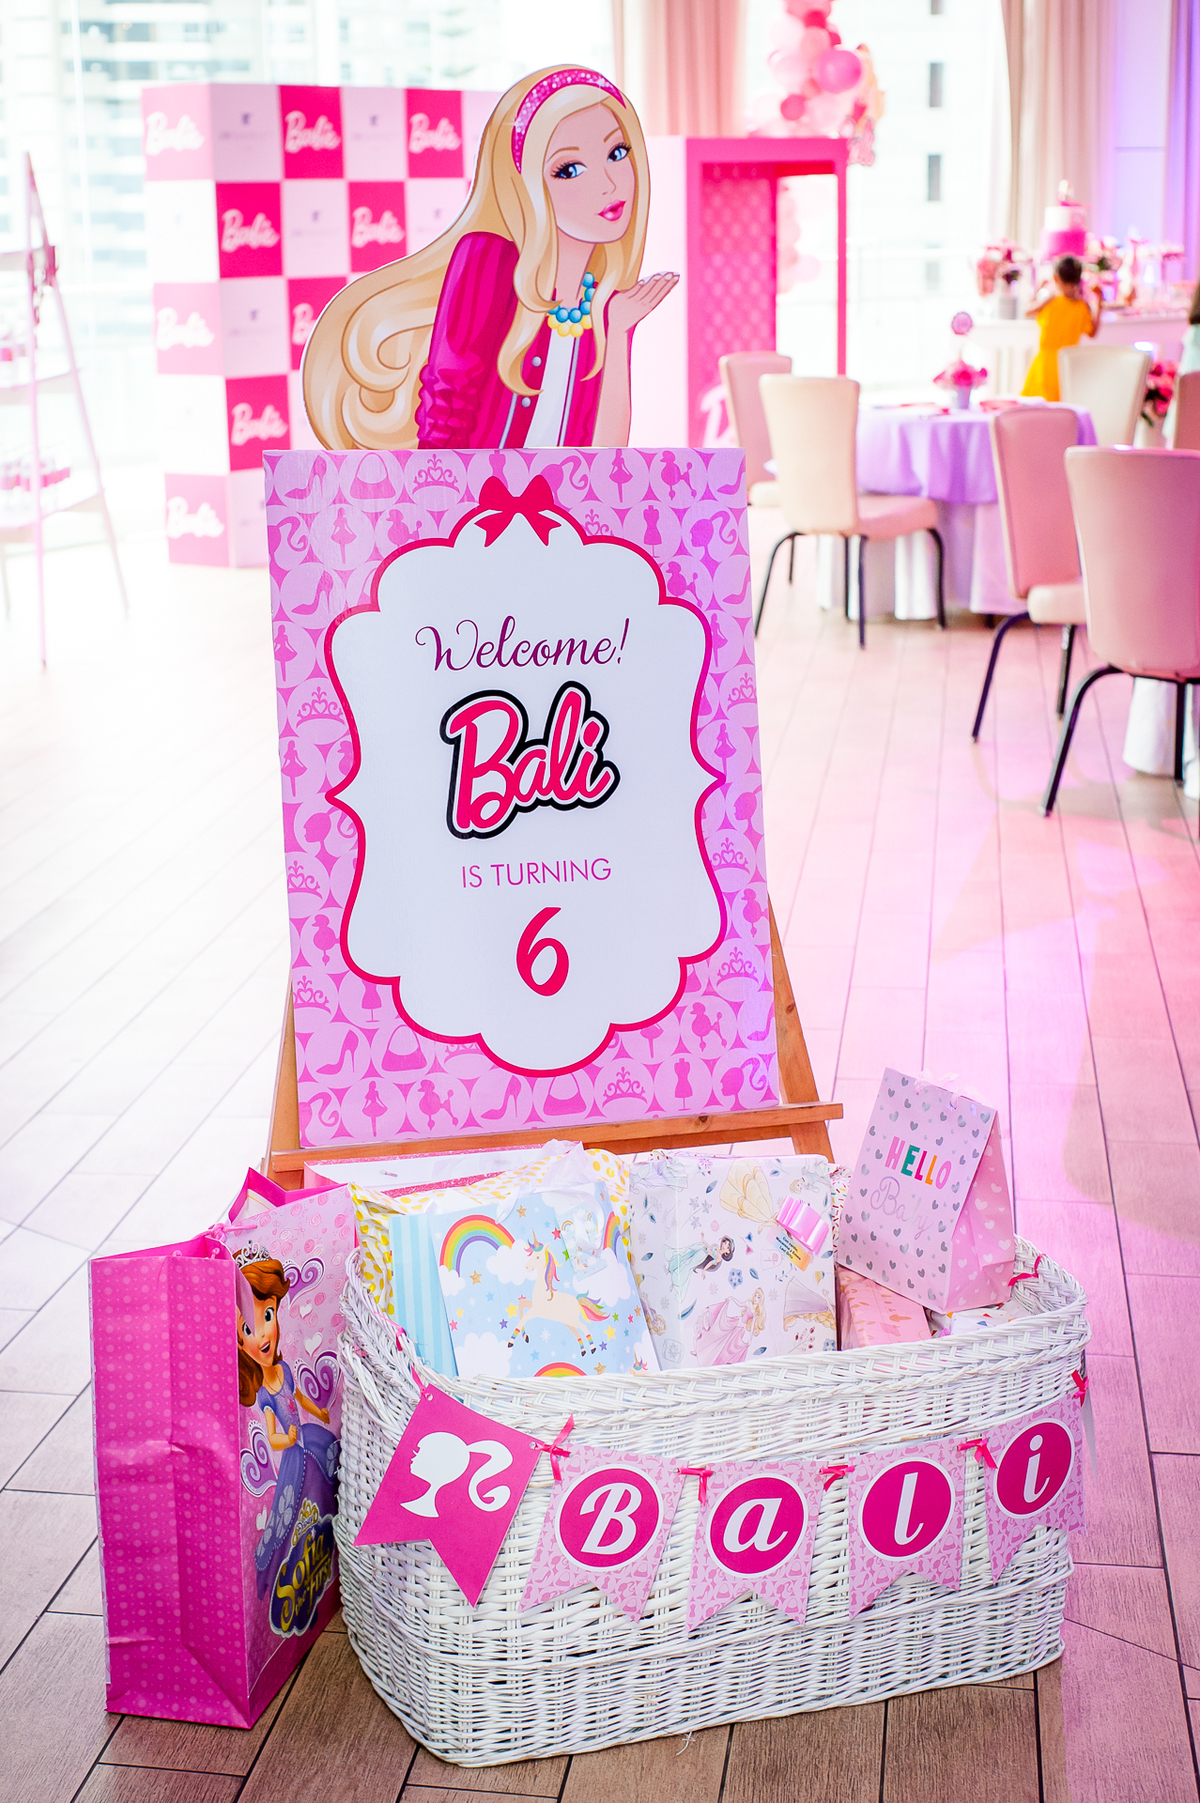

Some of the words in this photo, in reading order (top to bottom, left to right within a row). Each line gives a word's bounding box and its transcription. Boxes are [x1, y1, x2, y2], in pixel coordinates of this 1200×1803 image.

[415, 615, 630, 671] Welcome!
[441, 682, 619, 838] Bali
[462, 864, 483, 888] IS
[490, 857, 612, 886] TURNING
[516, 906, 570, 997] 6
[884, 1136, 952, 1190] HELLO
[276, 1532, 325, 1632] Sofia
